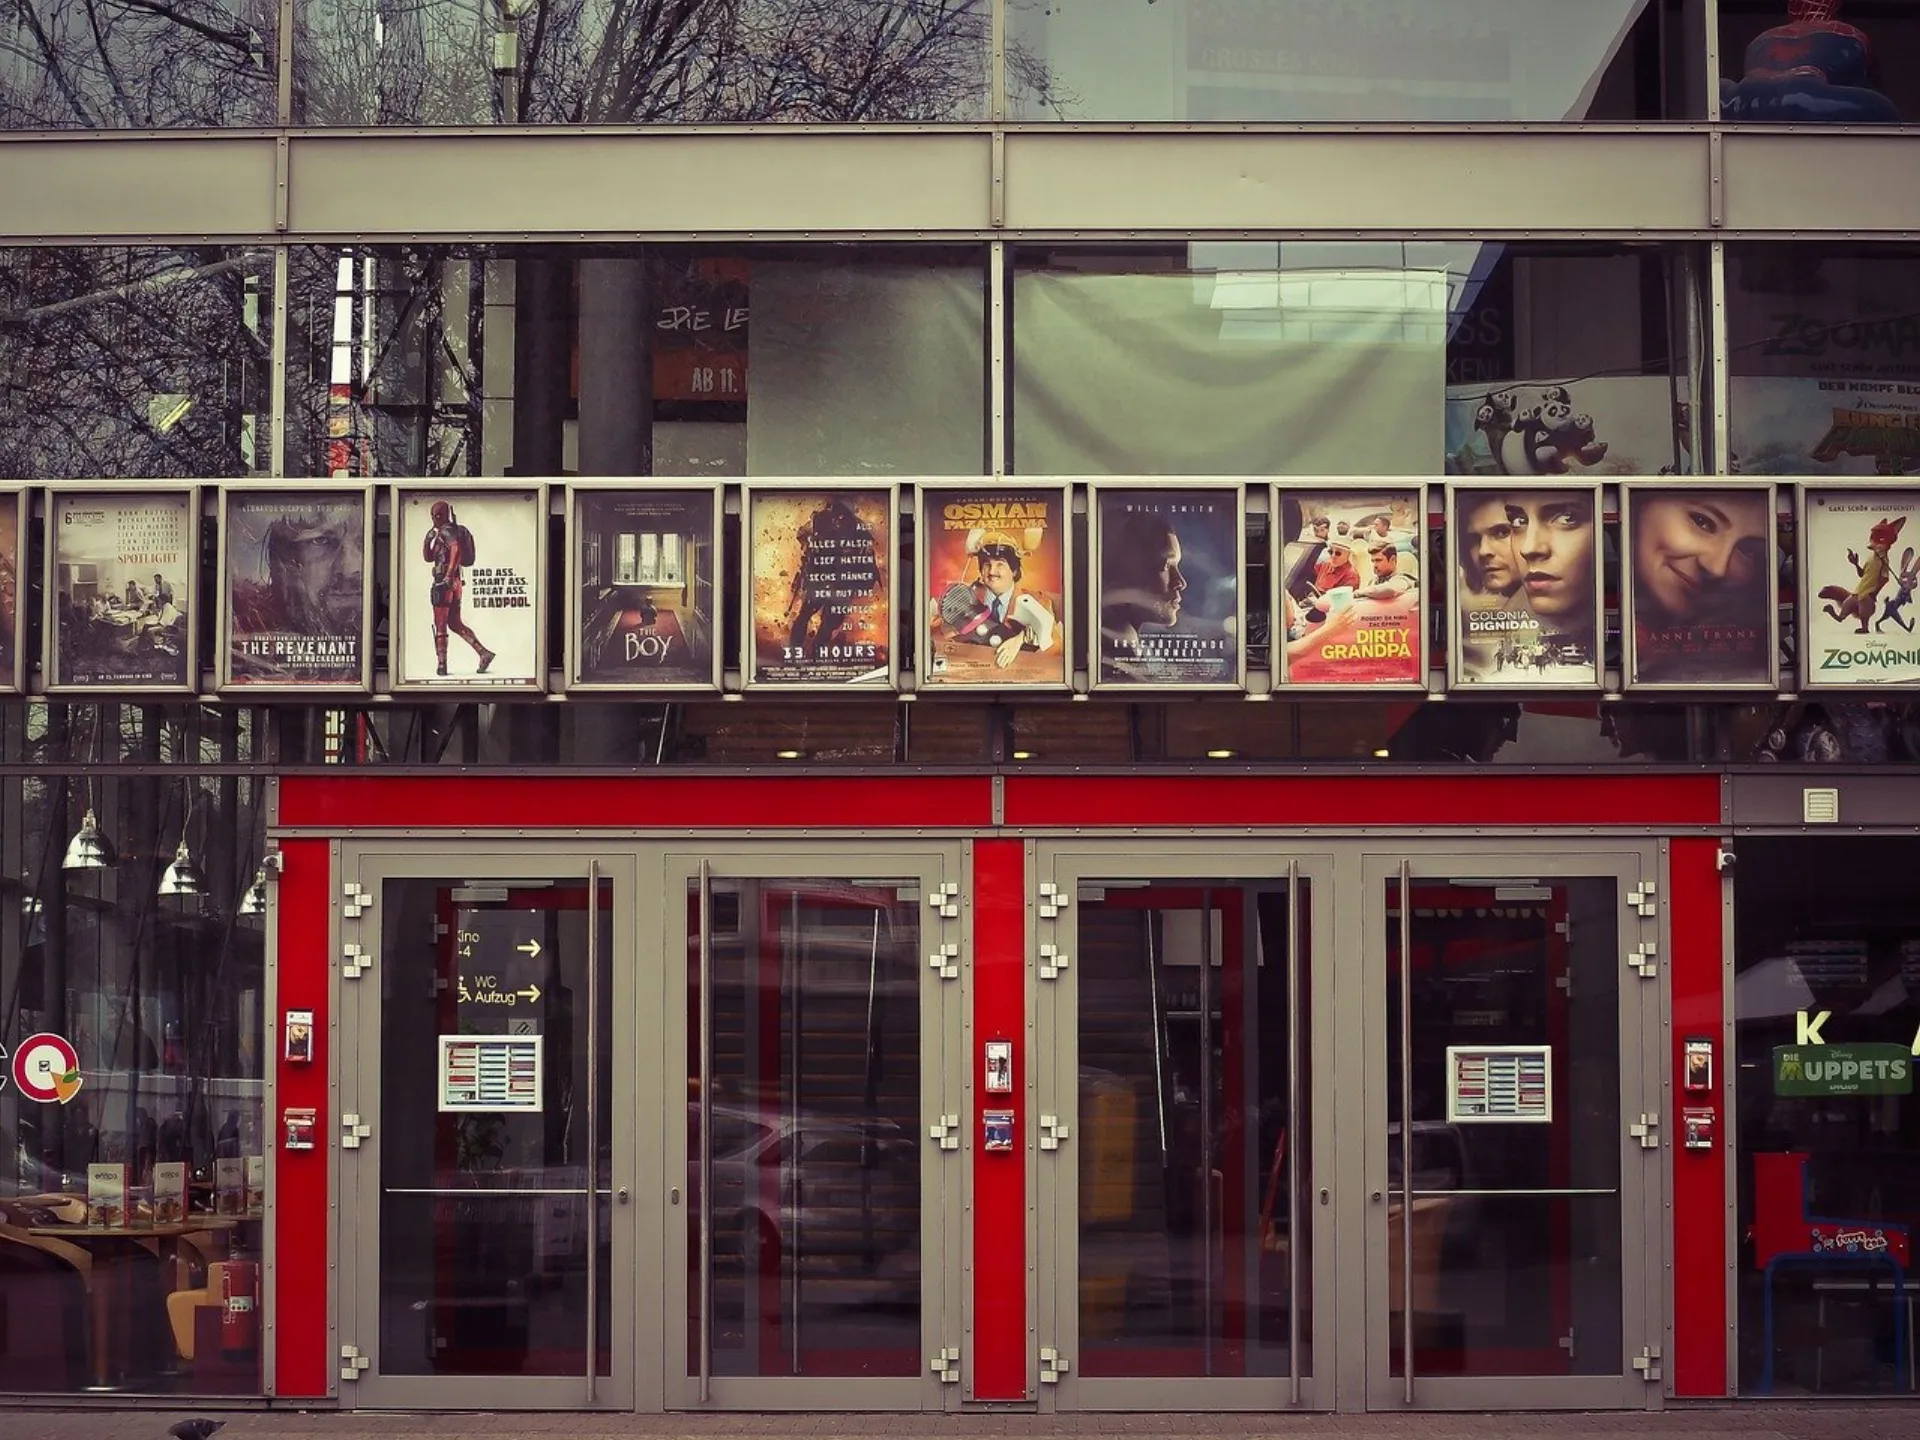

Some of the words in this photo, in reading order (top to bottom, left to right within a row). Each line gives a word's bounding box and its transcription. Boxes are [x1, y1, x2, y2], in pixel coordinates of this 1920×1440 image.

[691, 366, 714, 393] AB
[944, 503, 1048, 519] OSMAN
[1126, 505, 1159, 513] WILL
[1171, 504, 1214, 513] SMITH
[65, 511, 74, 526] 6
[944, 518, 1048, 530] PAZARLAMA
[808, 540, 835, 549] ALLES
[840, 539, 873, 548] FALSCH
[117, 553, 178, 565] SPOTLIGHT
[814, 556, 835, 565] LIEF
[840, 556, 874, 564] HATTEN
[472, 568, 492, 577] BAD
[495, 568, 516, 577] ASS.
[809, 573, 836, 582] SECHS
[840, 572, 874, 581] MÄNNER
[472, 577, 505, 586] SMART
[508, 577, 528, 586] ASS.
[472, 586, 503, 595] GREAT
[506, 586, 526, 595] ASS.
[815, 590, 831, 598] DEN
[836, 589, 853, 598] MUT
[857, 589, 874, 597] DAS
[473, 596, 531, 608] DEADPOOL
[1469, 611, 1530, 621] COLONIA
[1469, 620, 1540, 631] DIGNIDAD
[1357, 628, 1410, 644] DIRTY
[1649, 631, 1693, 641] ANNE
[1702, 629, 1757, 640] FRANK
[241, 641, 270, 655] THE
[276, 641, 357, 655] REVENANT
[820, 645, 875, 659] HOURS
[1321, 643, 1412, 659] GRANDPA
[474, 976, 497, 988] WC
[474, 991, 516, 1006] Aufzug
[1796, 1010, 1833, 1045] K
[1783, 1053, 1800, 1062] DIE
